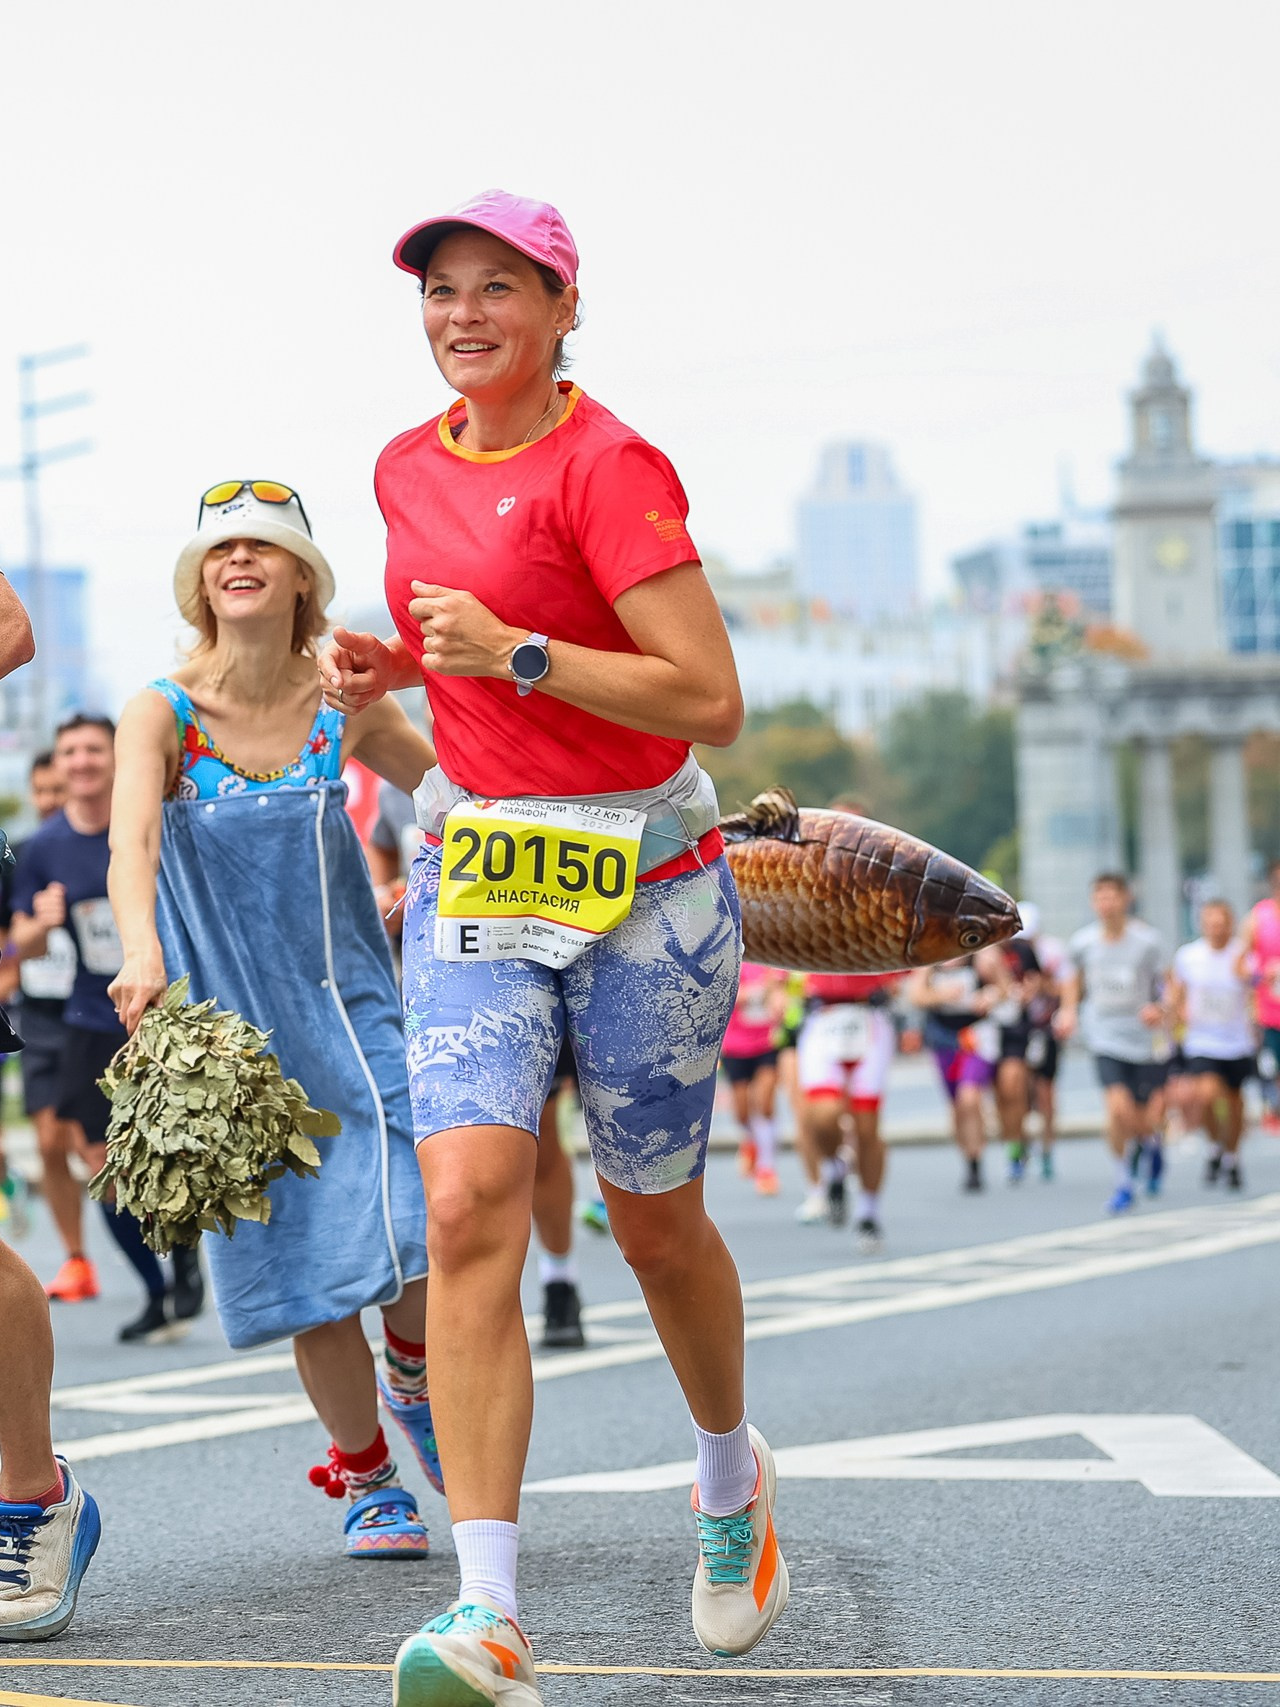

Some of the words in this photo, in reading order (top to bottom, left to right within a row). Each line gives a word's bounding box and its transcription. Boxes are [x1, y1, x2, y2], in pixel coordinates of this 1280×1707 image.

[499, 806, 548, 819] МАРАФОН
[501, 799, 567, 814] МОСКОВСКИЙ
[603, 812, 621, 822] КМ
[448, 827, 627, 900] 20150
[486, 889, 580, 914] АНАСТАСИЯ
[460, 925, 480, 954] E
